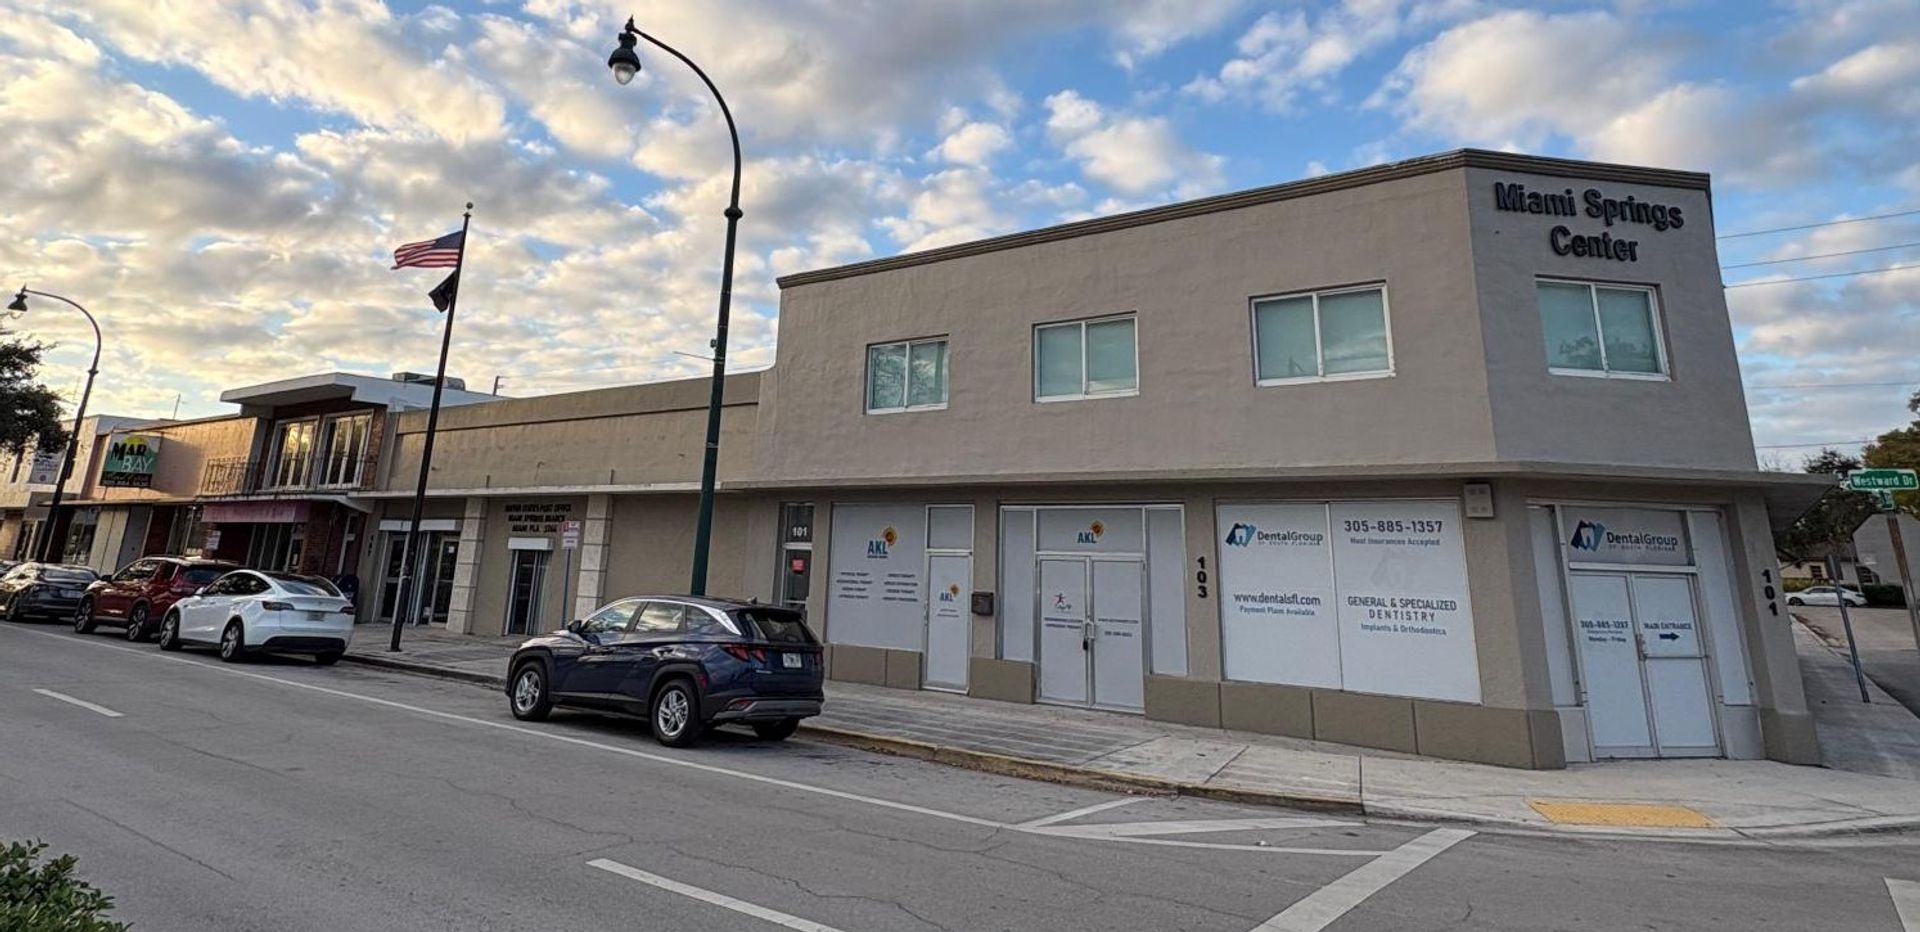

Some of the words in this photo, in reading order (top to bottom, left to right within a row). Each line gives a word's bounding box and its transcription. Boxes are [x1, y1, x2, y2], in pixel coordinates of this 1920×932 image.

[1494, 181, 1576, 217] Miami
[1583, 188, 1685, 231] Springs
[1550, 225, 1639, 262] Center
[110, 442, 147, 461] MAR
[121, 456, 153, 473] BAY
[1852, 475, 1900, 486] Westward
[1902, 475, 1914, 486] Dr
[792, 526, 808, 537] 101
[1344, 520, 1443, 533] 305-885-1357
[1077, 531, 1097, 544] AKL
[1257, 530, 1324, 545] DentalGroup
[1606, 531, 1678, 551] DentalGroup
[867, 540, 888, 555] AKL
[1196, 556, 1208, 598] 103
[940, 592, 954, 602] AKL
[1234, 592, 1321, 606] www.dentalsfl.com
[1762, 569, 1778, 616] 101
[1347, 596, 1388, 608] GENERAL
[1390, 598, 1397, 608] &
[1400, 598, 1458, 611] SPECIALIZED
[1369, 609, 1436, 622] DENTISTRY
[1361, 623, 1392, 633] Implants
[1400, 624, 1447, 636] Orthodontics
[1643, 622, 1660, 630] MAIN
[1661, 622, 1693, 630] ENTRANCE
